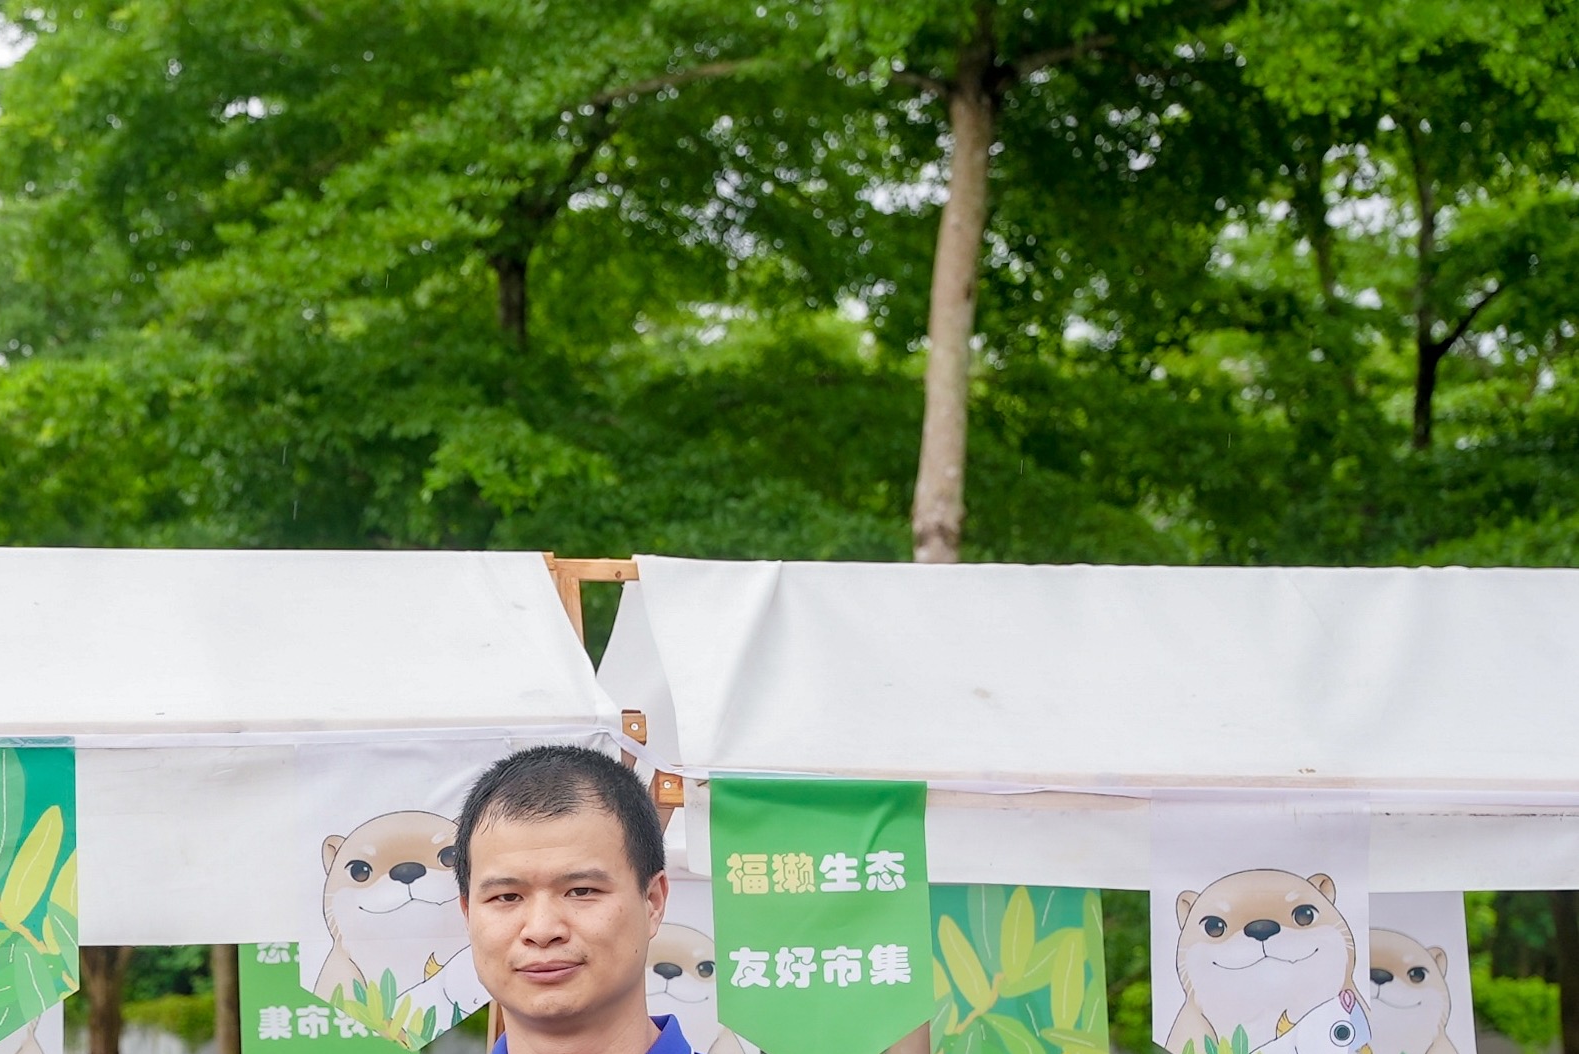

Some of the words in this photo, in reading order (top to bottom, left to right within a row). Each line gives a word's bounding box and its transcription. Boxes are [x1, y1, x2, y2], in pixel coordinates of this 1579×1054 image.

[726, 850, 906, 894] 福獭生态
[729, 943, 911, 988] 友好市集
